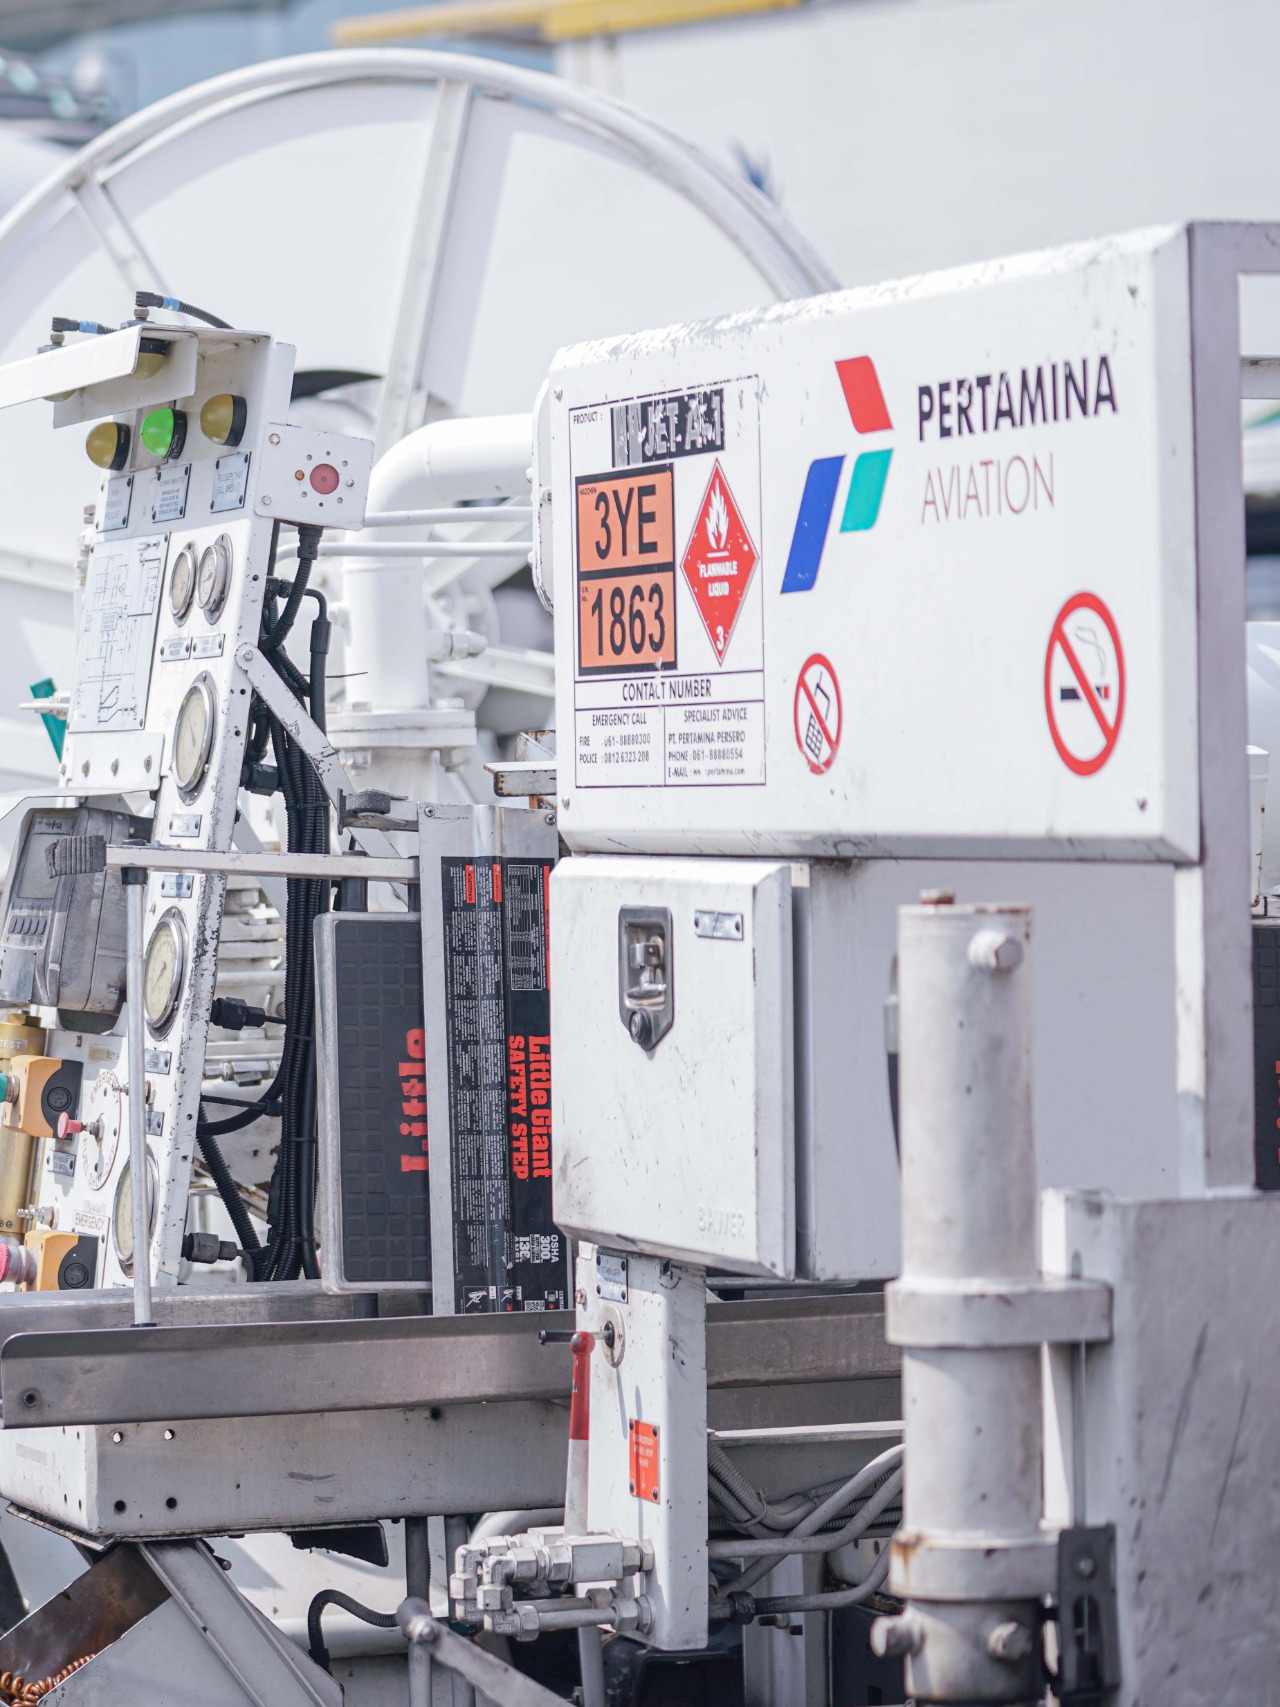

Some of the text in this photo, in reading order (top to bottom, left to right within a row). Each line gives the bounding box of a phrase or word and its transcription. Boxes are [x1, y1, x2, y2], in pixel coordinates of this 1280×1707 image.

[918, 353, 1118, 442] PERTAMINA
[573, 411, 598, 425] PRODUCT
[644, 400, 679, 457] JET
[921, 451, 1055, 525] AVIATION
[594, 484, 658, 560] 3YE
[699, 560, 738, 578] FLAMMABLE
[707, 581, 730, 598] LIQUID
[591, 582, 666, 656] 1863
[716, 625, 724, 651] 3
[622, 679, 712, 702] CONTACT NUMBER
[592, 711, 647, 727] EMERGENCY CALL
[683, 707, 748, 723] SPECIALIST ADVICE
[579, 735, 590, 747] FIRE
[678, 731, 715, 745] PERTAMINA
[717, 730, 746, 743] PERSERO
[579, 752, 597, 764] POLICE
[668, 750, 688, 762] PHONE
[668, 766, 688, 777] E-MAIL
[0, 1039, 22, 1049] TEST
[509, 1035, 529, 1180] SAFETY STEP
[528, 1035, 553, 1179] Little Giant
[75, 1212, 105, 1230] EMERGENCY
[540, 1235, 550, 1260] 300
[550, 1234, 559, 1263] OSHA
